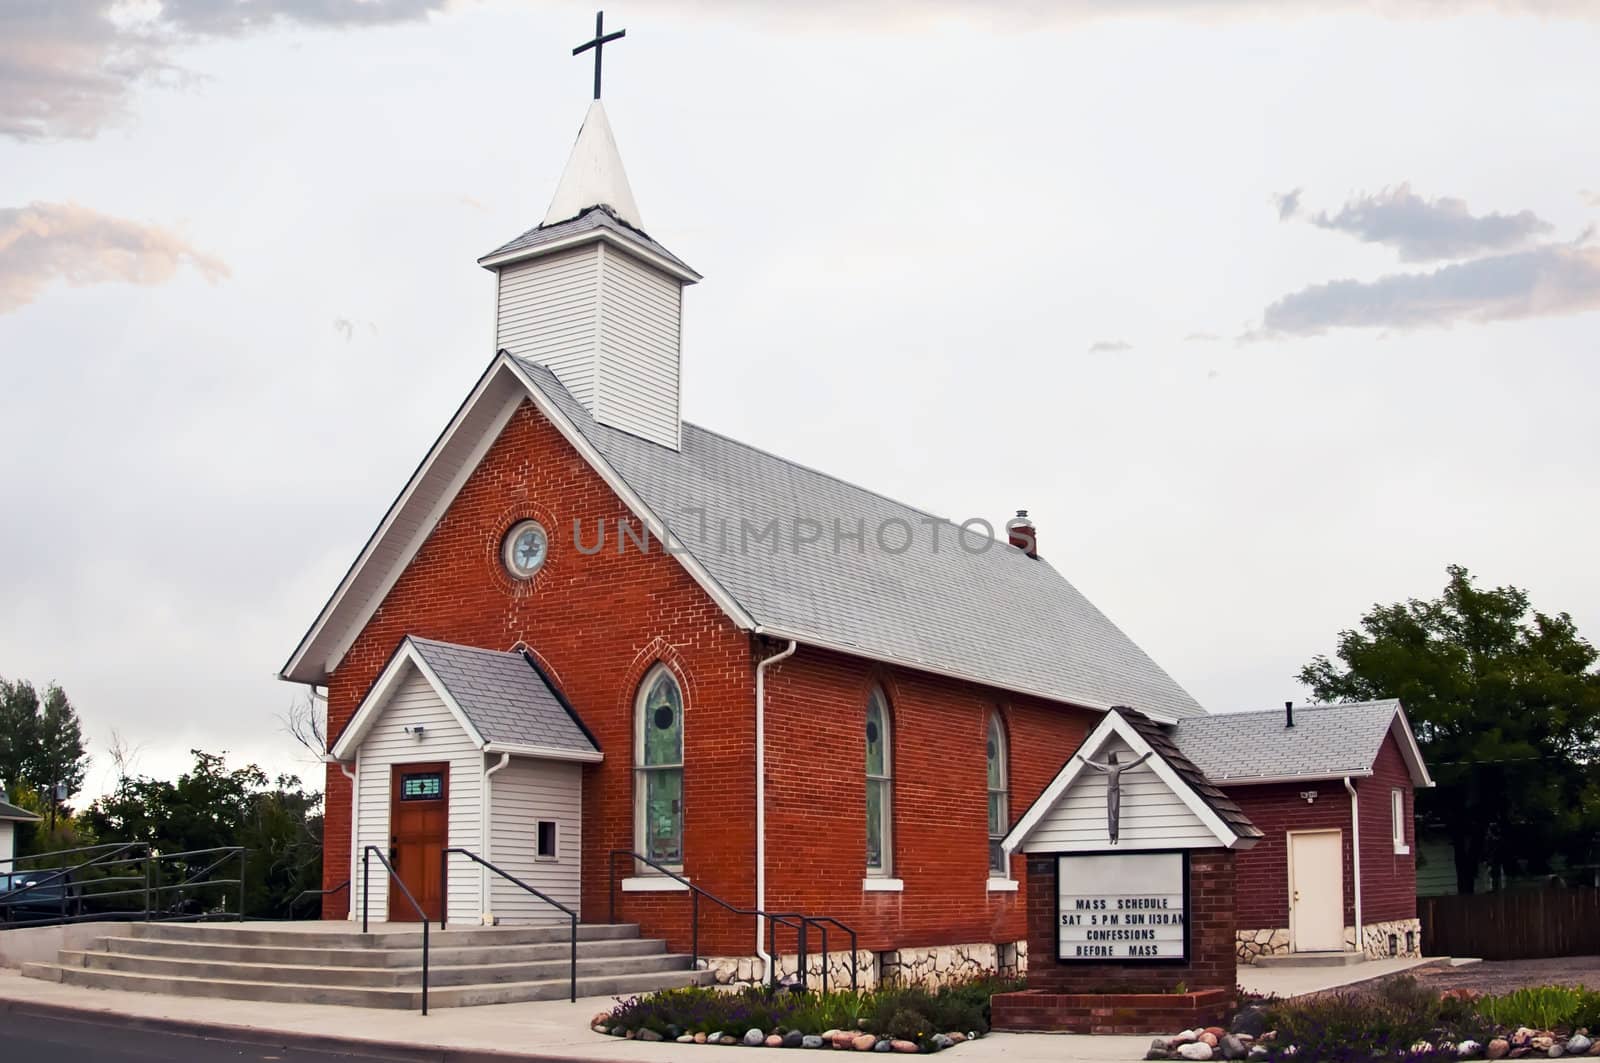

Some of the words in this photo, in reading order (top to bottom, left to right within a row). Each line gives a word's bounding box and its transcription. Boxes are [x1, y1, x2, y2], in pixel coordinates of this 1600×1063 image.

[1076, 899, 1106, 910] MASS
[1118, 898, 1167, 909] SCHEDULE
[1062, 915, 1081, 925] SAT
[1092, 915, 1097, 925] 5
[1125, 914, 1145, 925] SUN
[1087, 929, 1155, 940] CONFESSIONS
[1076, 946, 1113, 956] BEFORE
[1129, 945, 1158, 956] MASS
